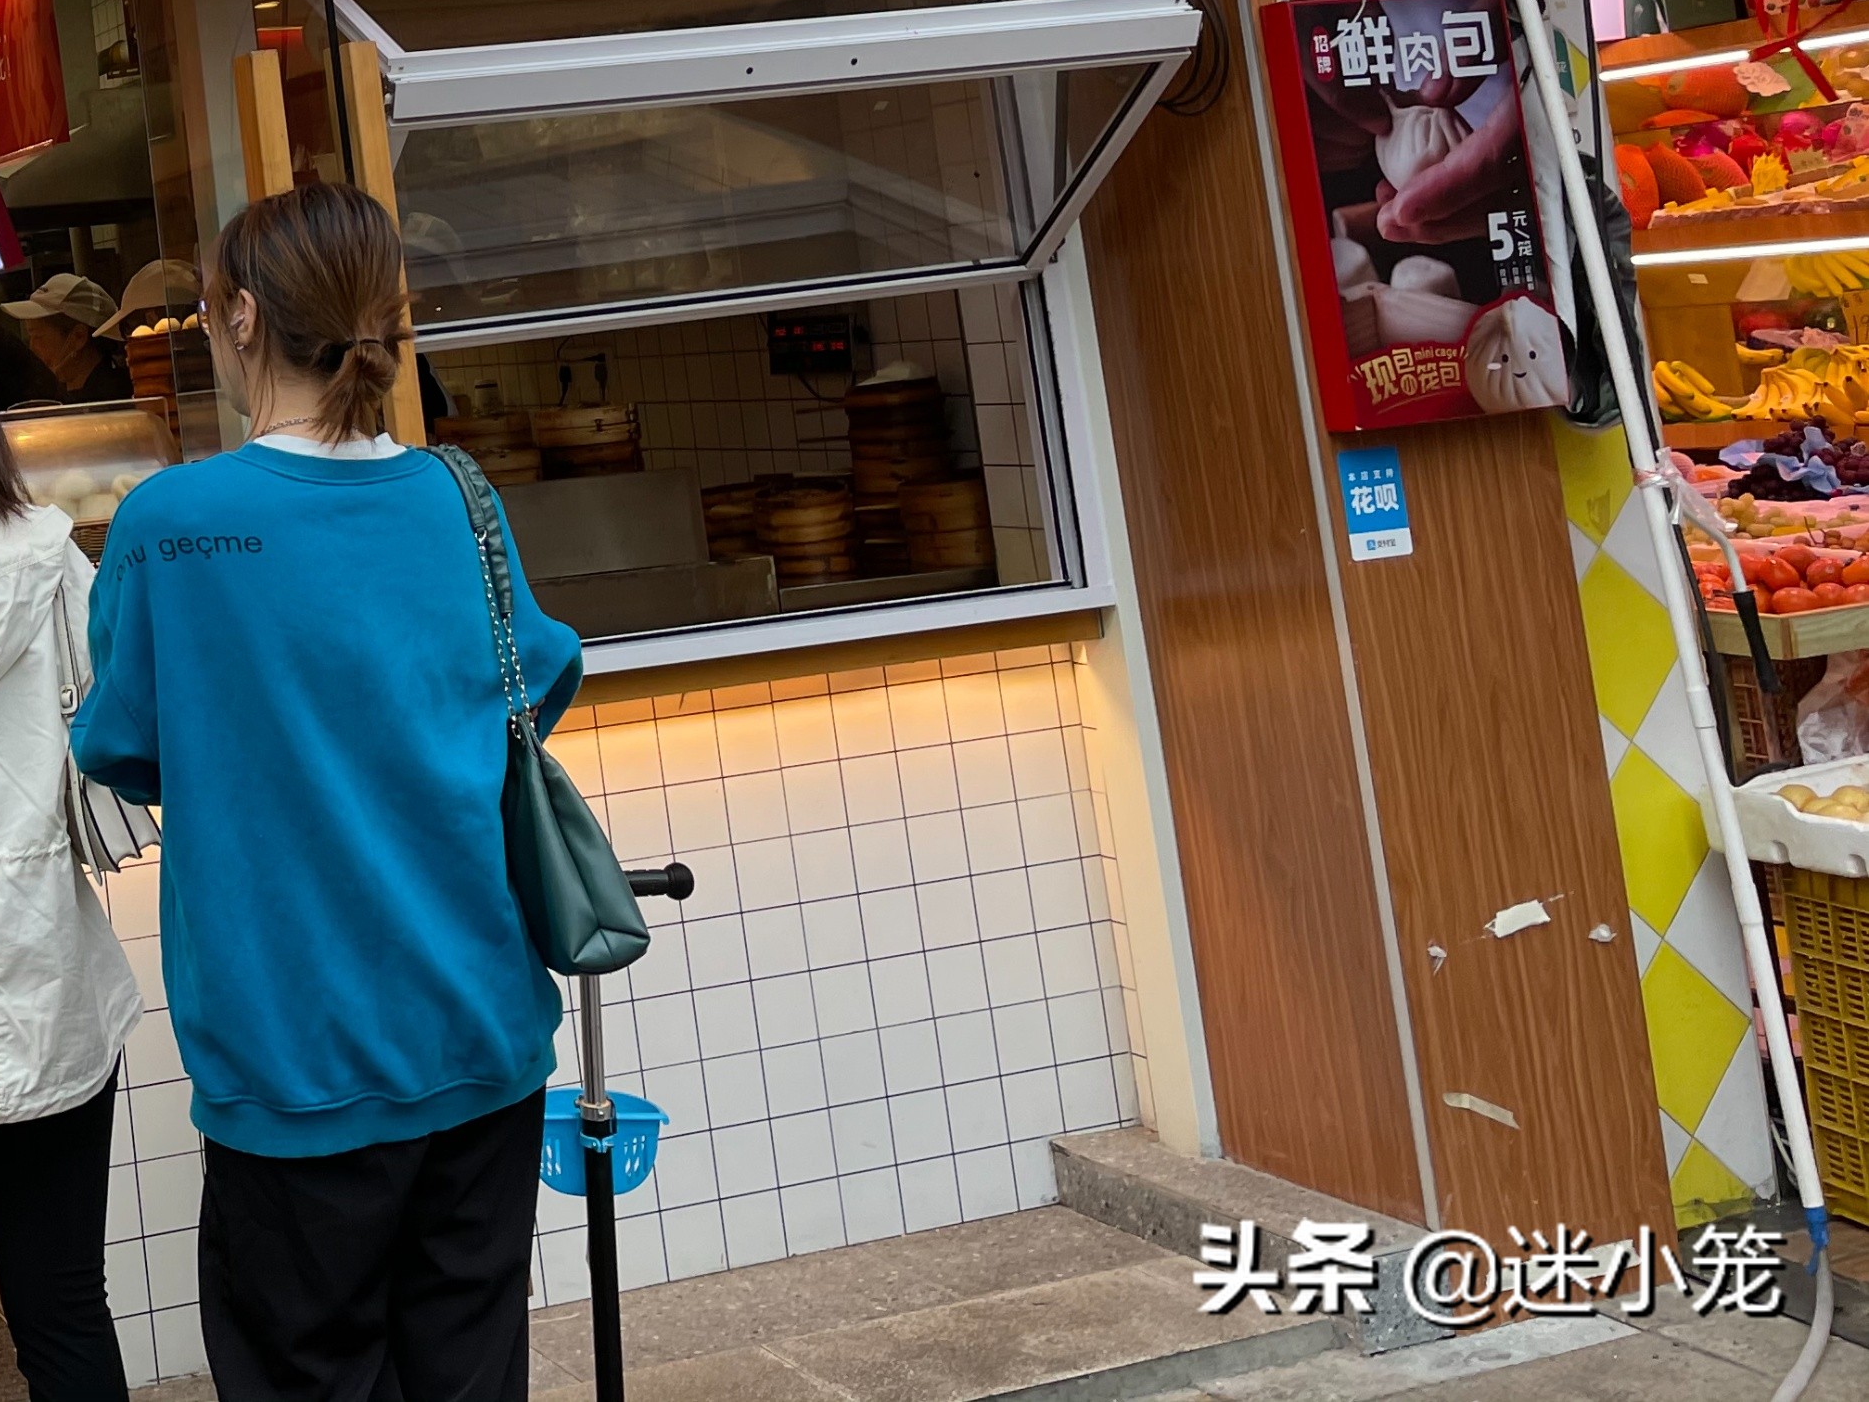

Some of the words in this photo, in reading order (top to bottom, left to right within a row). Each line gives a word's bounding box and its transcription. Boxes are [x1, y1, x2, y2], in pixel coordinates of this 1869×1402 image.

[1337, 10, 1498, 88] 鲜肉包
[1350, 483, 1400, 516] 花呗
[158, 535, 263, 562] geçme
